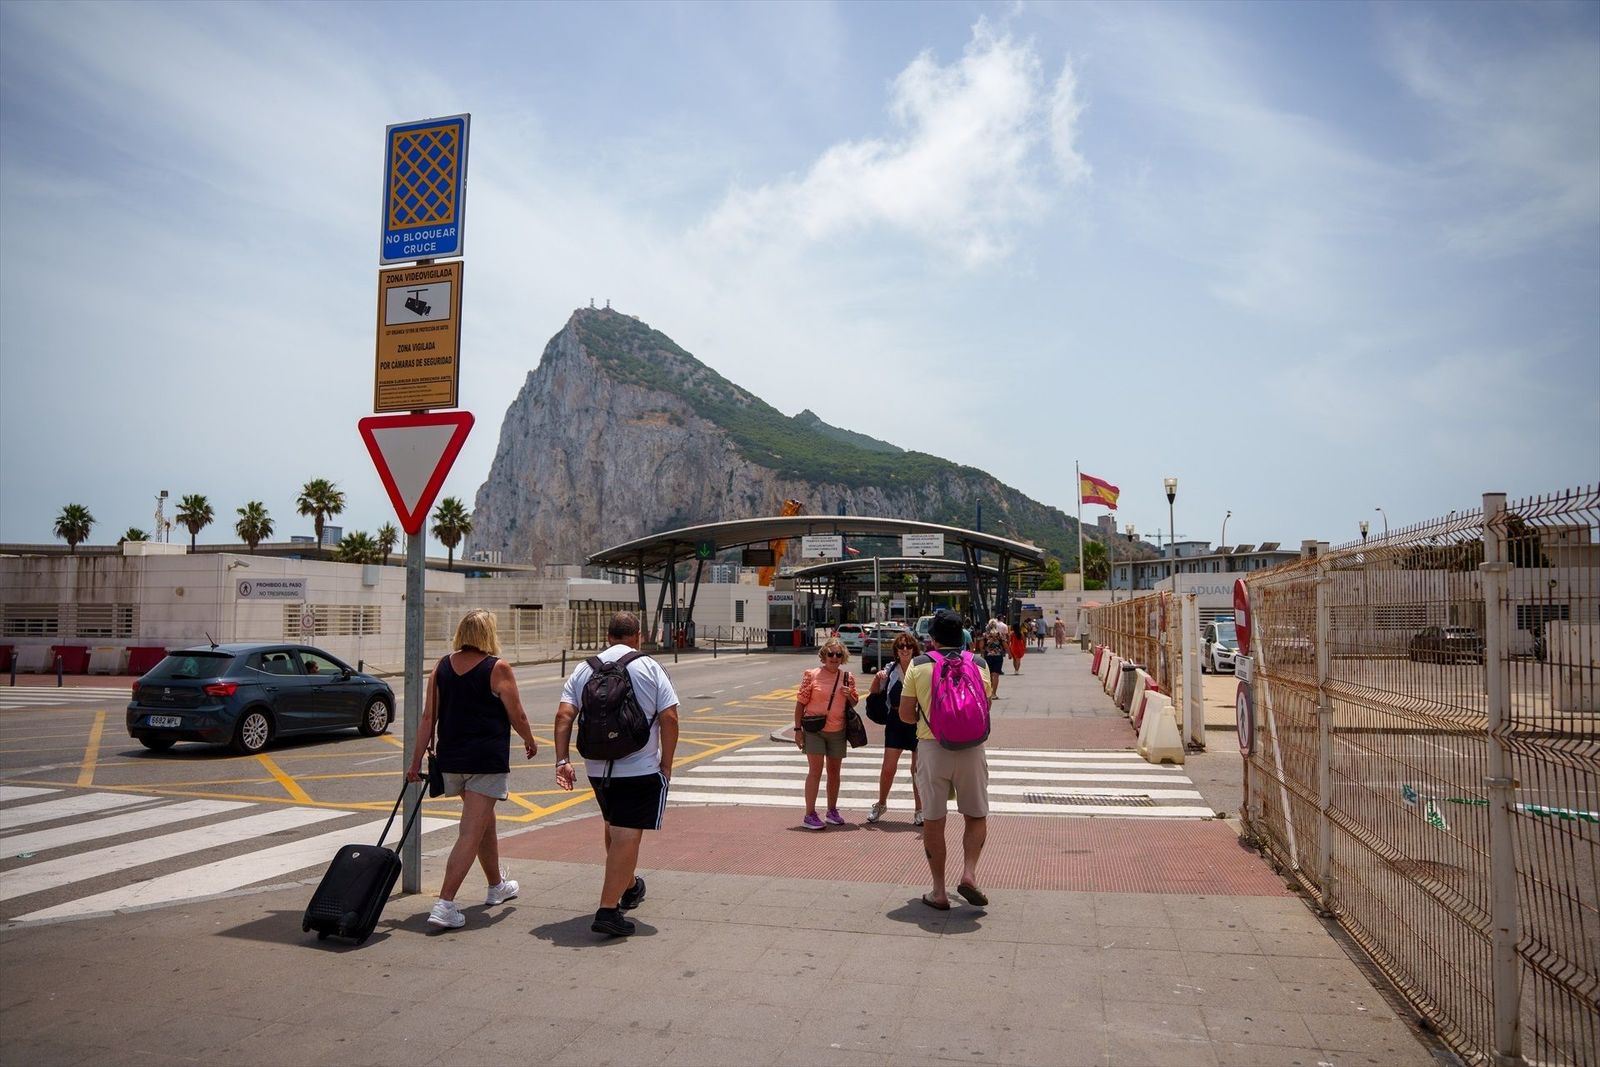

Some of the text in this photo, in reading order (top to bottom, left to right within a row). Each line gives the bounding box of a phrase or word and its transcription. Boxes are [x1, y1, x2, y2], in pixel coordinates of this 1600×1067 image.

[386, 228, 455, 244] NO BLOQUEAR
[404, 242, 436, 254] CRUCE
[386, 269, 452, 283] ZONA VIDEOVIGILADA
[398, 342, 435, 353] ZONA VIGILADA
[380, 361, 391, 370] POR
[416, 359, 422, 367] DE
[424, 356, 452, 366] SEGURIDAD
